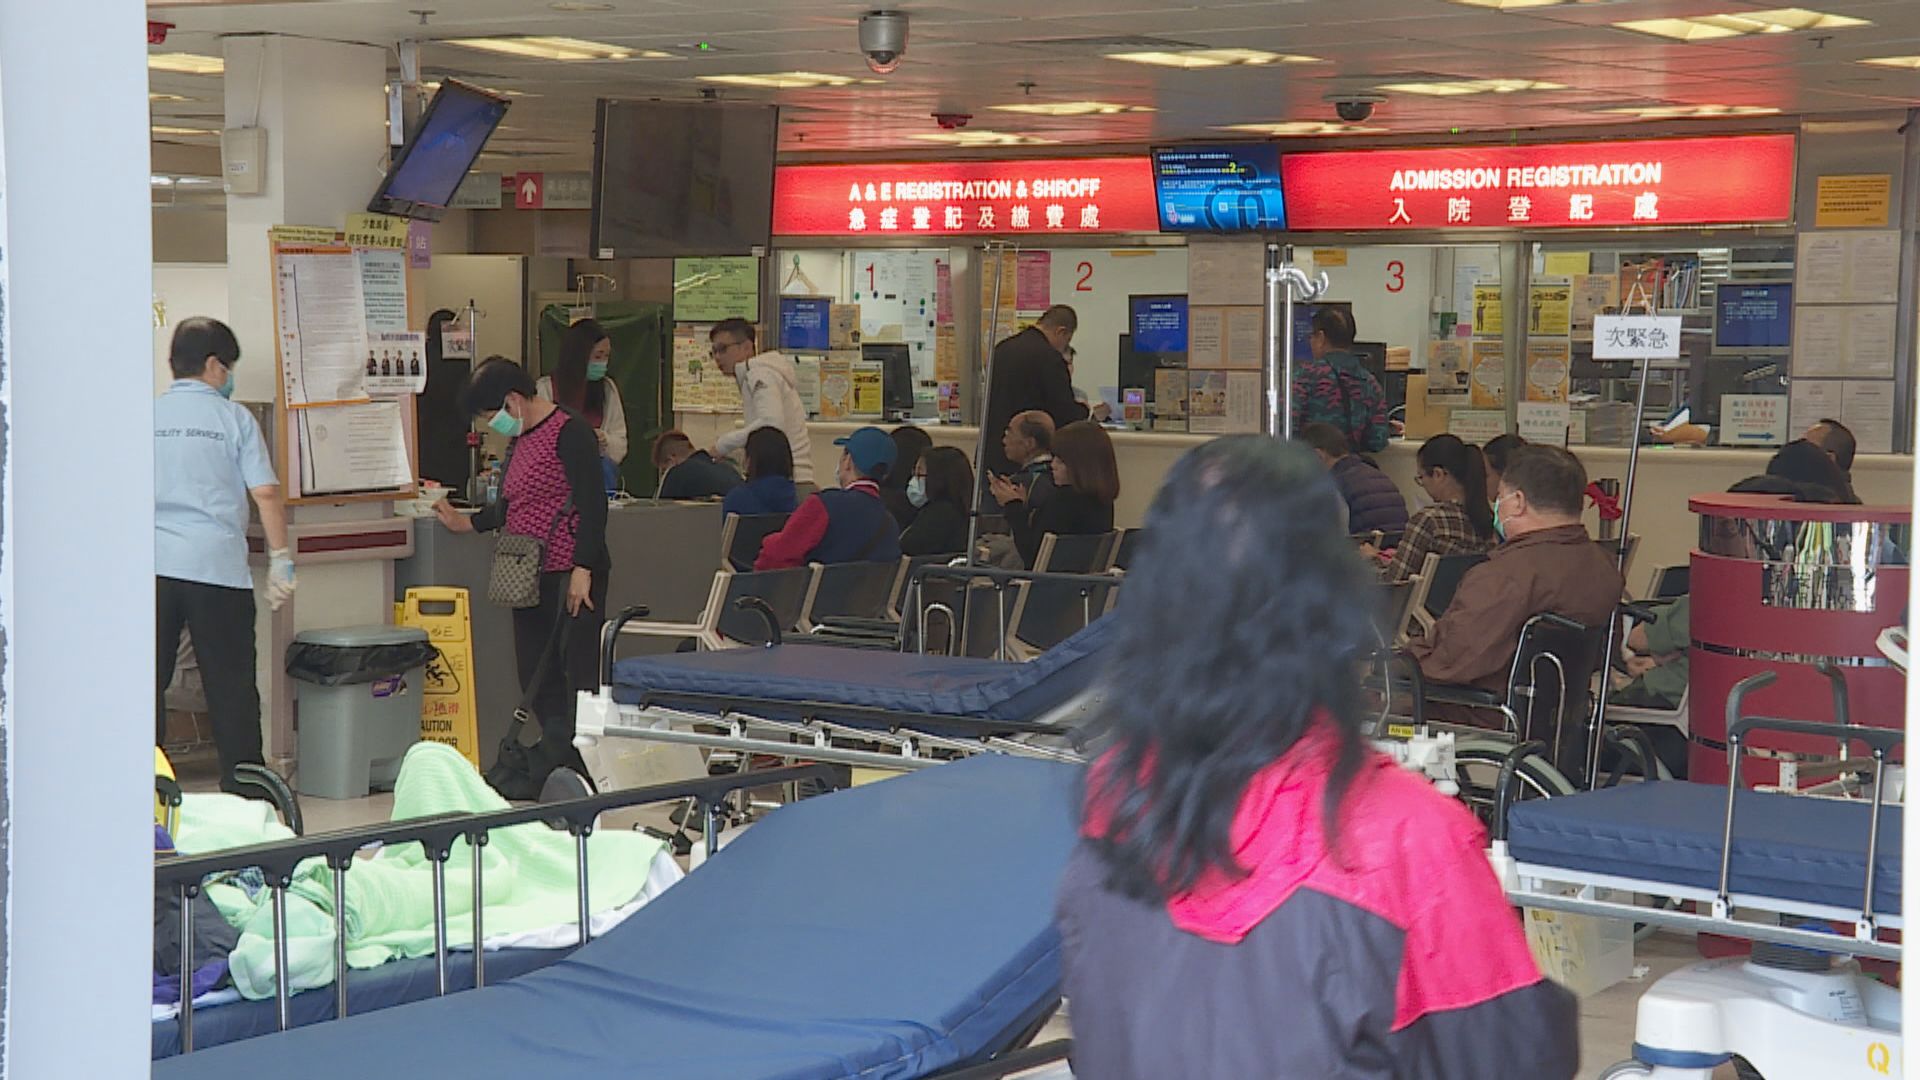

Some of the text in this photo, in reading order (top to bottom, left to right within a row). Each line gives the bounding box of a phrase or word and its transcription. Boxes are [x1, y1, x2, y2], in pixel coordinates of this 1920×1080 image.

[848, 177, 1101, 201] A & E REGISTRATION & SHROFF
[1390, 162, 1662, 191] ADMISSION REGISTRATION
[848, 203, 1100, 231] 急症登記及繳費處
[1389, 192, 1660, 223] 入院登記處
[866, 262, 874, 291] 1
[1076, 262, 1093, 291] 2
[1386, 260, 1405, 293] 3
[1604, 326, 1669, 349] 次緊急
[420, 720, 453, 732] AUTION
